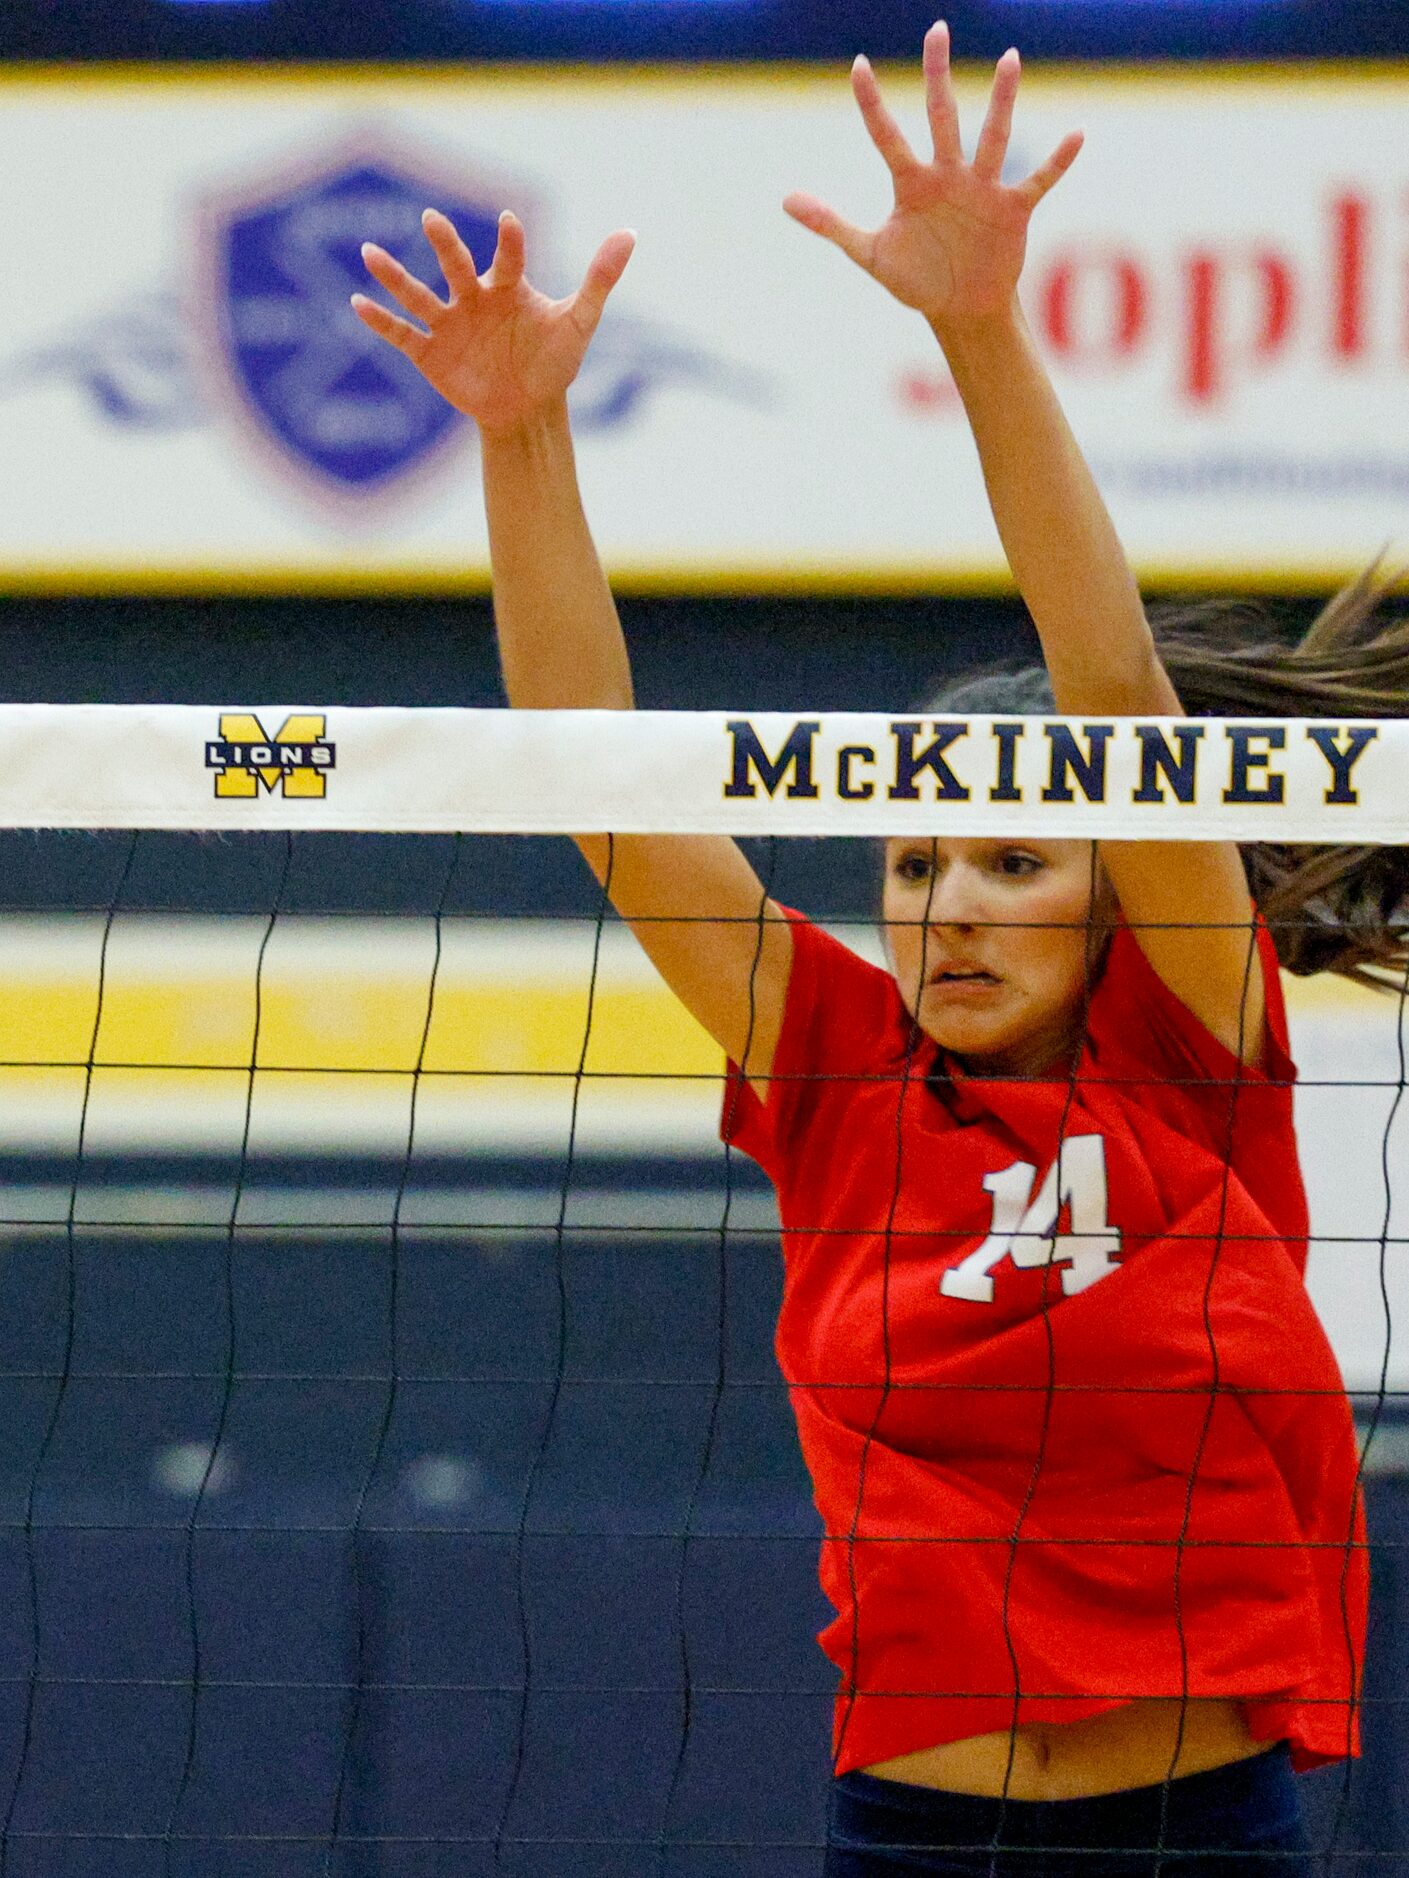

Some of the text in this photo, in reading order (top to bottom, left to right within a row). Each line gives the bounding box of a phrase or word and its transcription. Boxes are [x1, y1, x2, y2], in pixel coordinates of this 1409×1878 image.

[209, 745, 332, 765] LIONS
[722, 719, 1380, 805] McKINNEY
[939, 1133, 1124, 1303] 14
